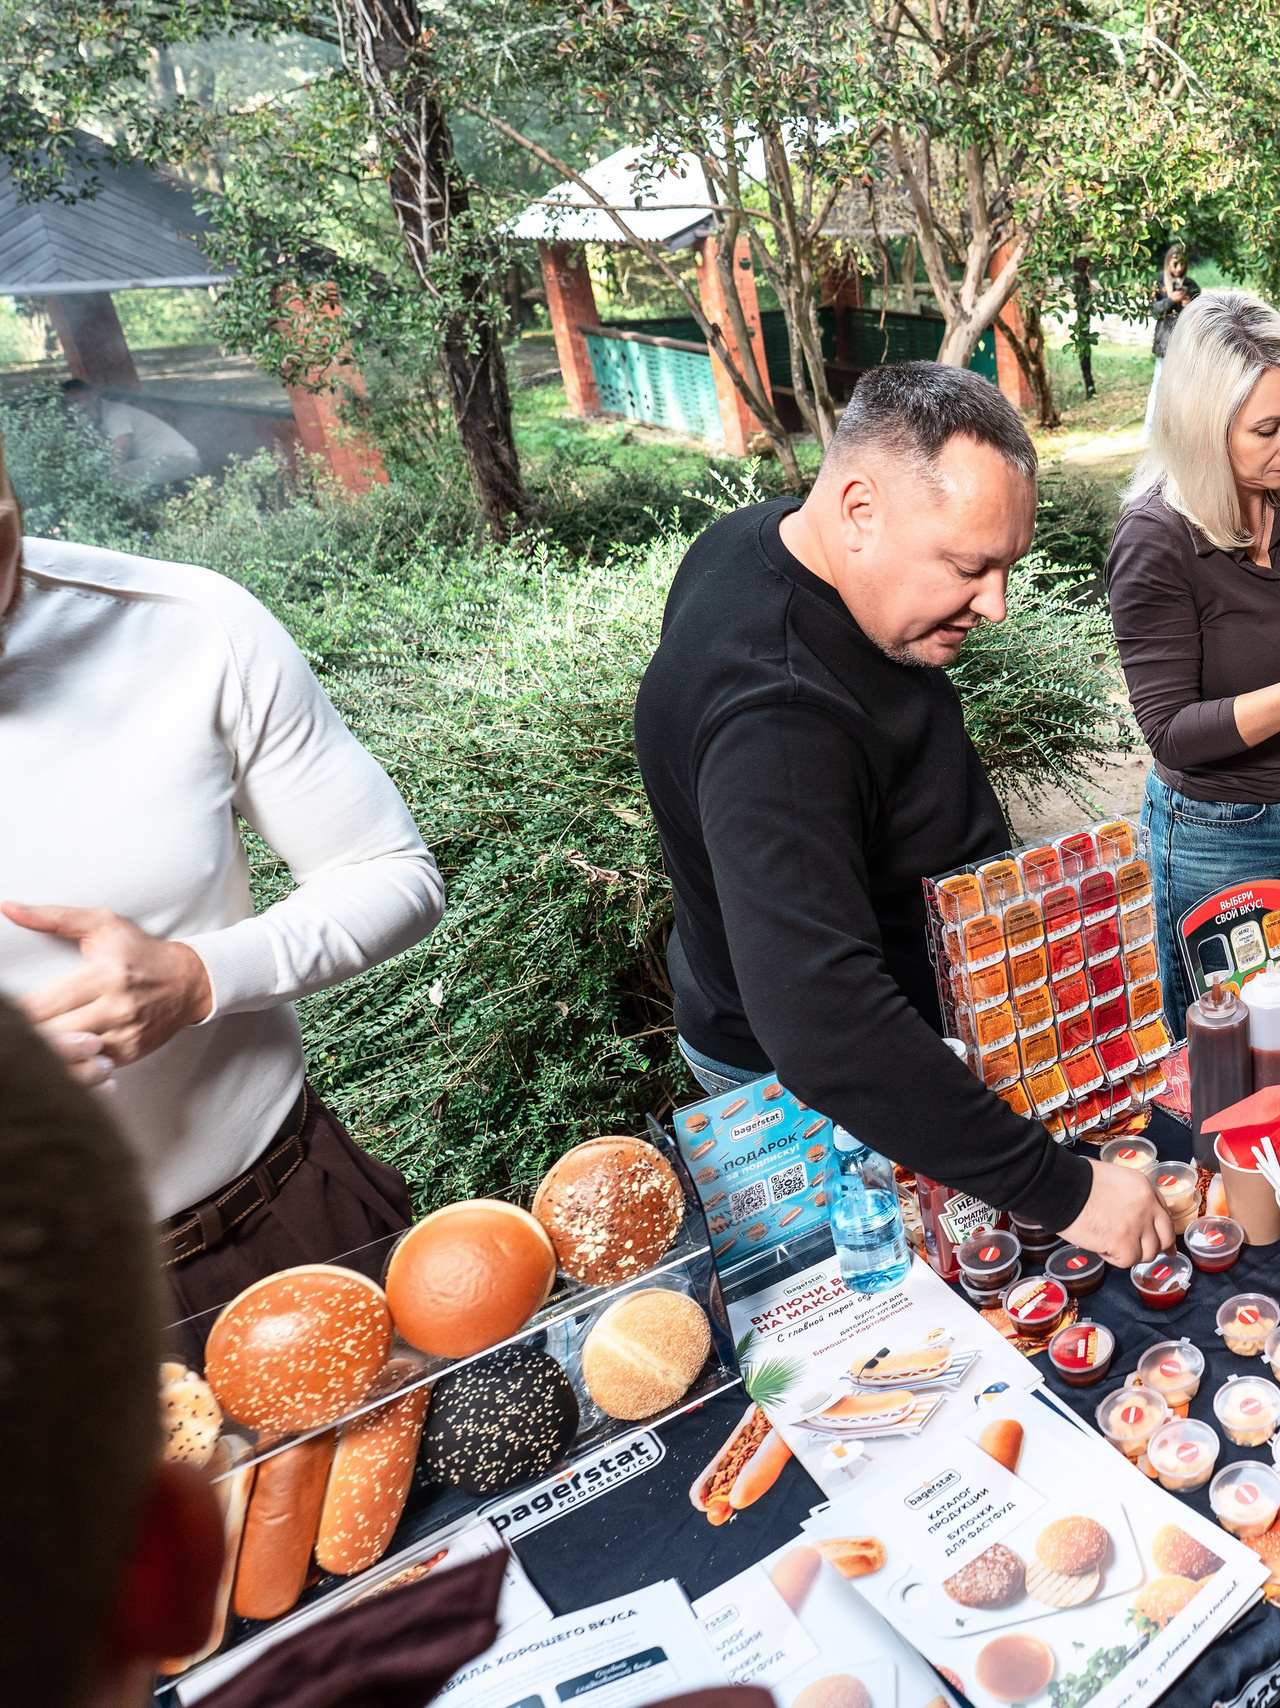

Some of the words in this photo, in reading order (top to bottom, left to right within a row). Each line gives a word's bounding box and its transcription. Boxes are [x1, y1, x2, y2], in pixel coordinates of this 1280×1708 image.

[1215, 907, 1239, 925] СВОЙ
[1239, 898, 1264, 914] ВКУС!
[1219, 890, 1254, 911] ВЫБЕРИ
[1238, 927, 1250, 936] HEINZ
[734, 1113, 779, 1136] bagerstat
[724, 1132, 798, 1171] ПОДАРОК
[726, 1171, 739, 1181] за
[742, 1143, 800, 1175] подписку!
[963, 1213, 988, 1229] КЕТЧУП
[786, 1274, 824, 1294] bagerstat
[750, 1285, 827, 1326] ВКЛЮЧИ
[777, 1333, 785, 1343] С
[788, 1314, 824, 1337] главной
[828, 1300, 854, 1319] парой
[839, 1315, 875, 1337] датского
[875, 1296, 909, 1318] хот-дога
[853, 1300, 888, 1321] Булочки
[888, 1291, 904, 1303] для
[756, 1319, 783, 1334] НА
[812, 1337, 848, 1357] Бриошь
[854, 1301, 914, 1335] Картофельная
[488, 1440, 649, 1531] bagerstat
[559, 1453, 653, 1508] FOODSERVICE
[908, 1472, 956, 1506] bagerstat
[927, 1488, 989, 1534] ПРОДУКЦИИ
[928, 1486, 971, 1520] КАТАЛОГ
[945, 1538, 967, 1557] ДЛЯ
[967, 1501, 1016, 1538] ФАСТФУД
[947, 1504, 994, 1540] БУЛОЧКИ
[497, 1626, 585, 1664] ХОРОШЕГО
[588, 1608, 638, 1631] ВКУСА
